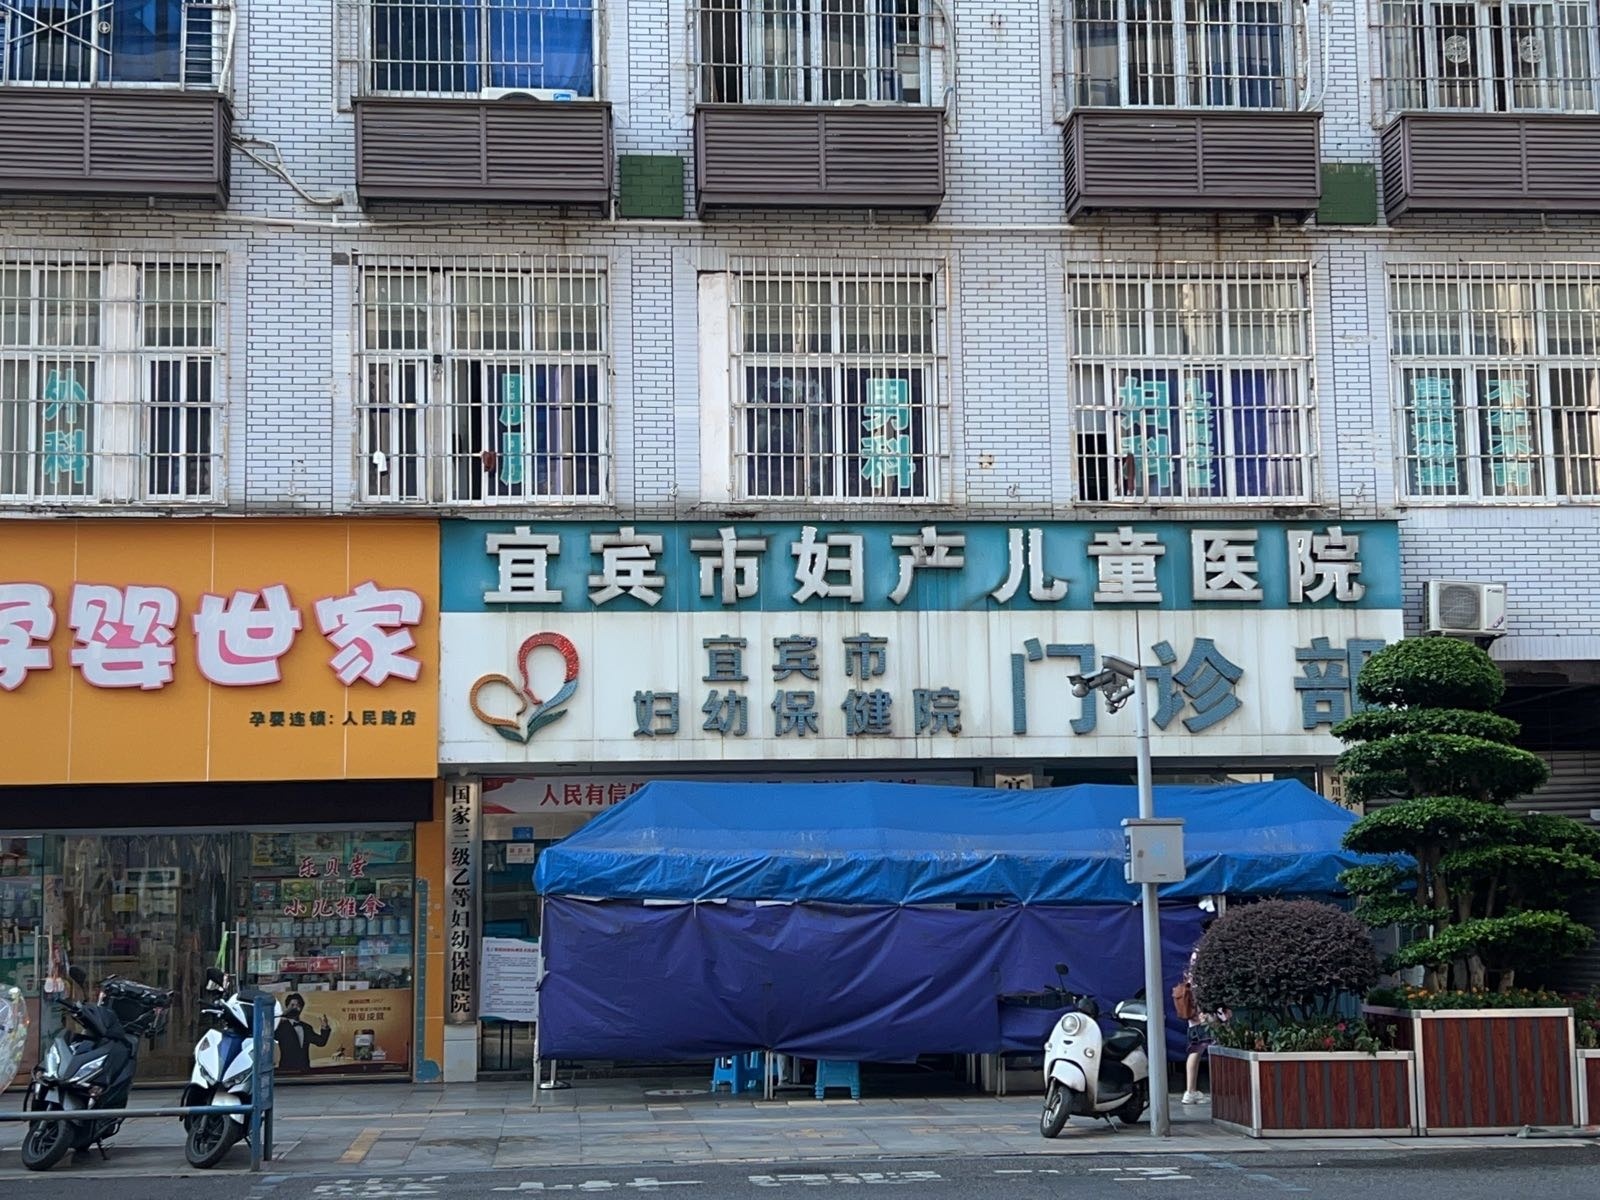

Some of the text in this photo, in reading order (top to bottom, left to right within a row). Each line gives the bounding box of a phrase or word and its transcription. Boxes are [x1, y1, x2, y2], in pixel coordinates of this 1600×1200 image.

[484, 526, 1366, 606] 宜宾市妇产儿童医院
[702, 632, 888, 682] 宜宾市
[633, 688, 962, 737] 妇幼保健院
[540, 782, 645, 806] 人民有信
[284, 893, 386, 920] 小儿推拿
[450, 784, 472, 1013] 国家三级乙等妇幼保健院
